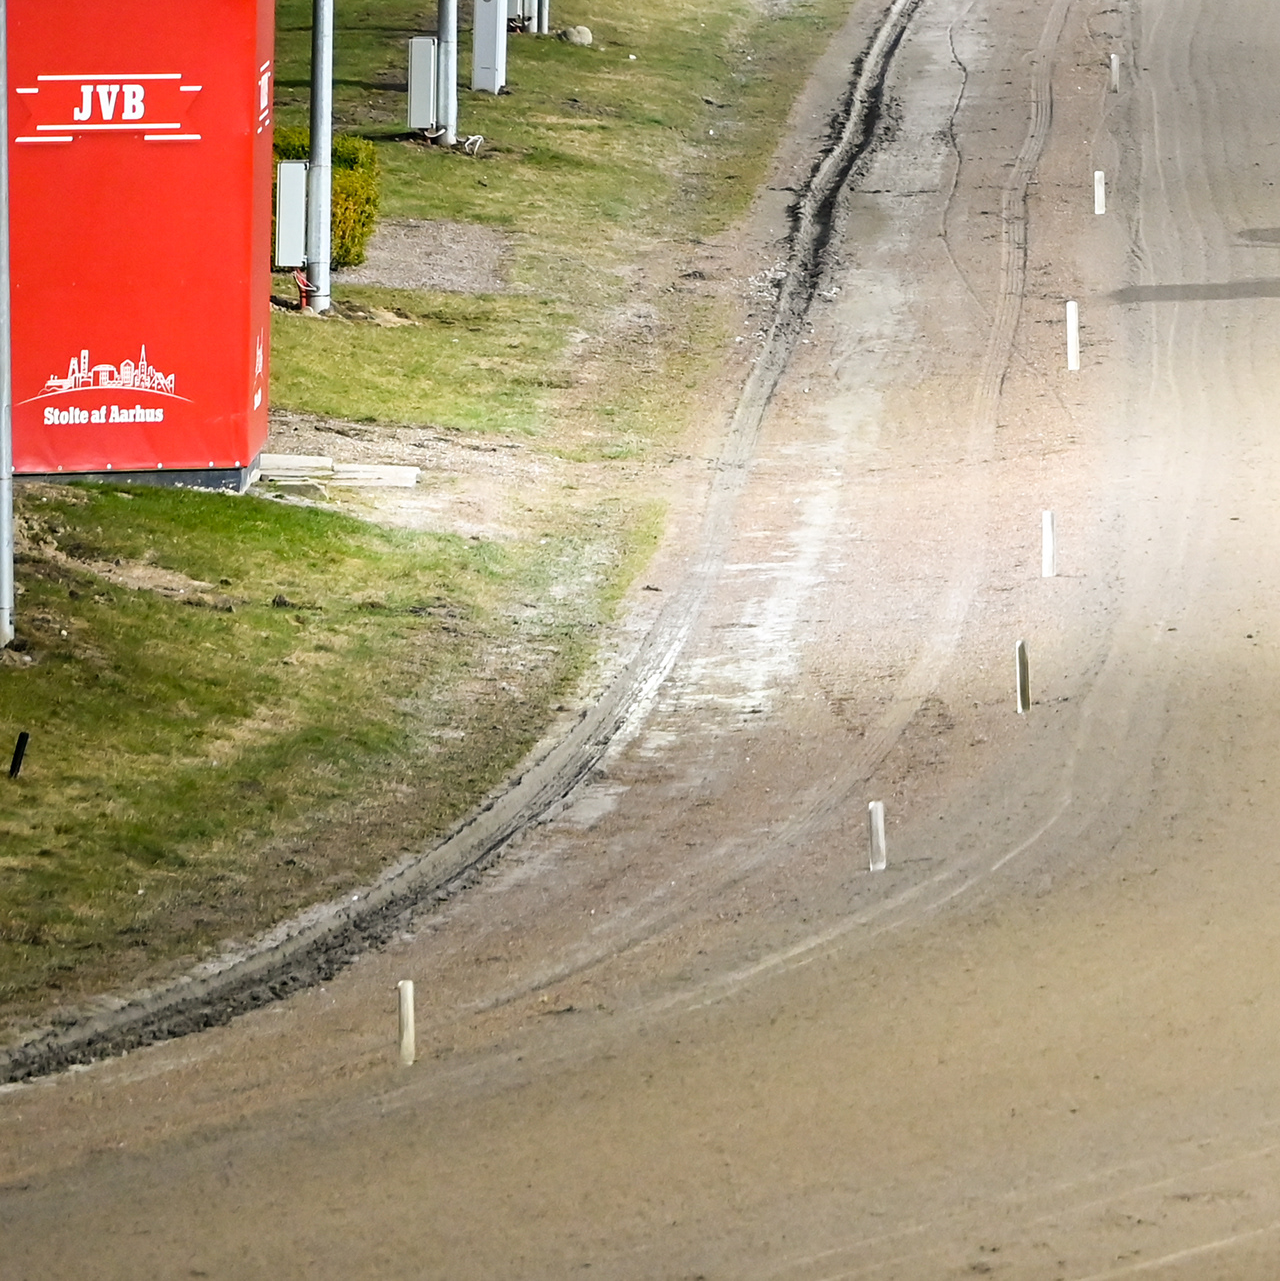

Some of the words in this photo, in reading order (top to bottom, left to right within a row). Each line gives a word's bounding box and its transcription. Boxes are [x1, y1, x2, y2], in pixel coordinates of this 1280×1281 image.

[73, 84, 145, 120] JVB
[44, 406, 89, 425] Stolte
[90, 405, 107, 424] af
[108, 404, 164, 423] Aarhus
